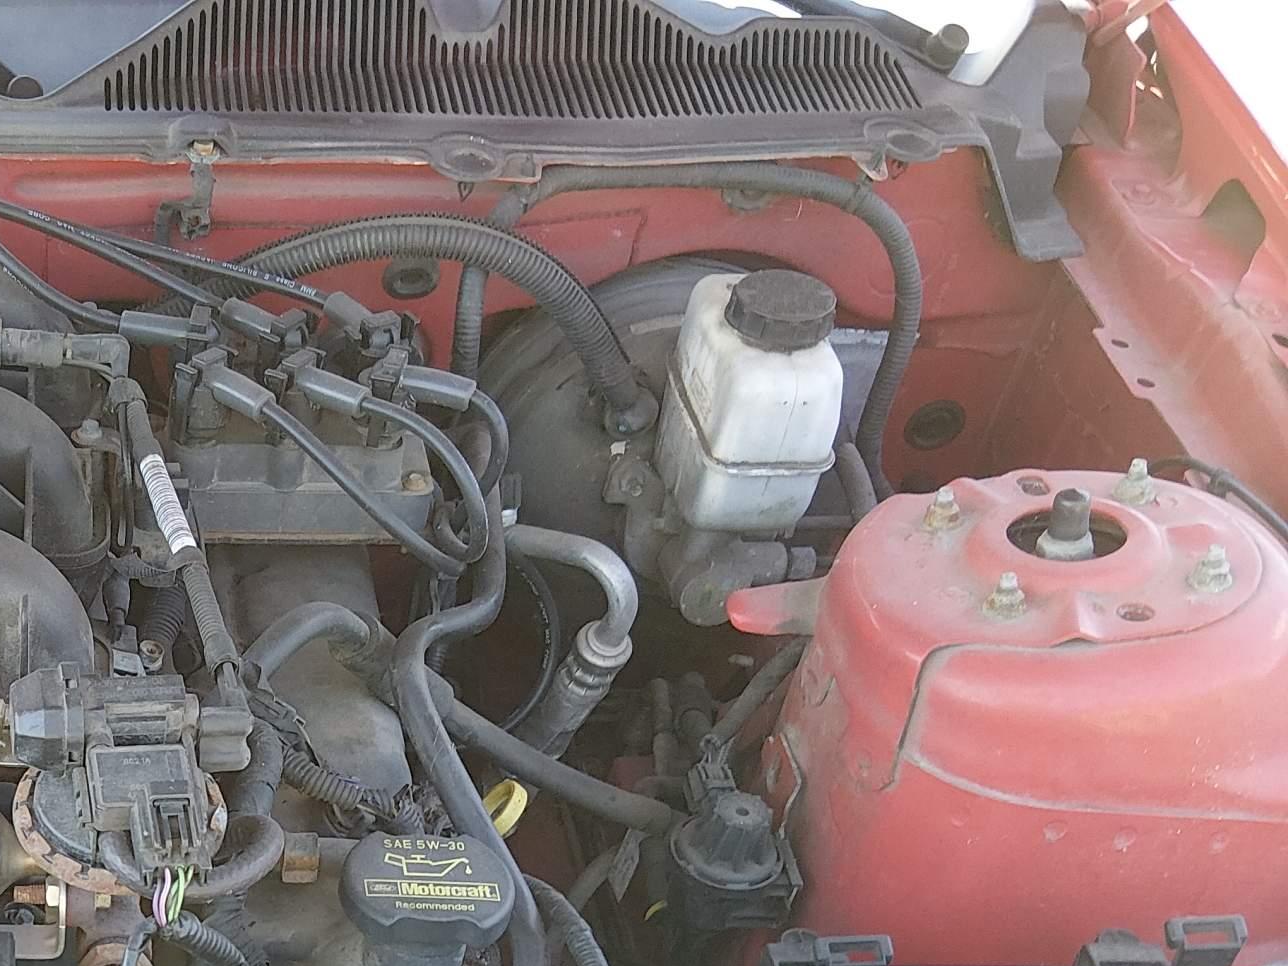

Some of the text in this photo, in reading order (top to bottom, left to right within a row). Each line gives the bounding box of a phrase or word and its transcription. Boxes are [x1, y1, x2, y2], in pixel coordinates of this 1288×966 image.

[383, 839, 465, 851] SAE 5W-30
[401, 882, 491, 898] Motorcraft
[395, 901, 475, 912] Recommended
